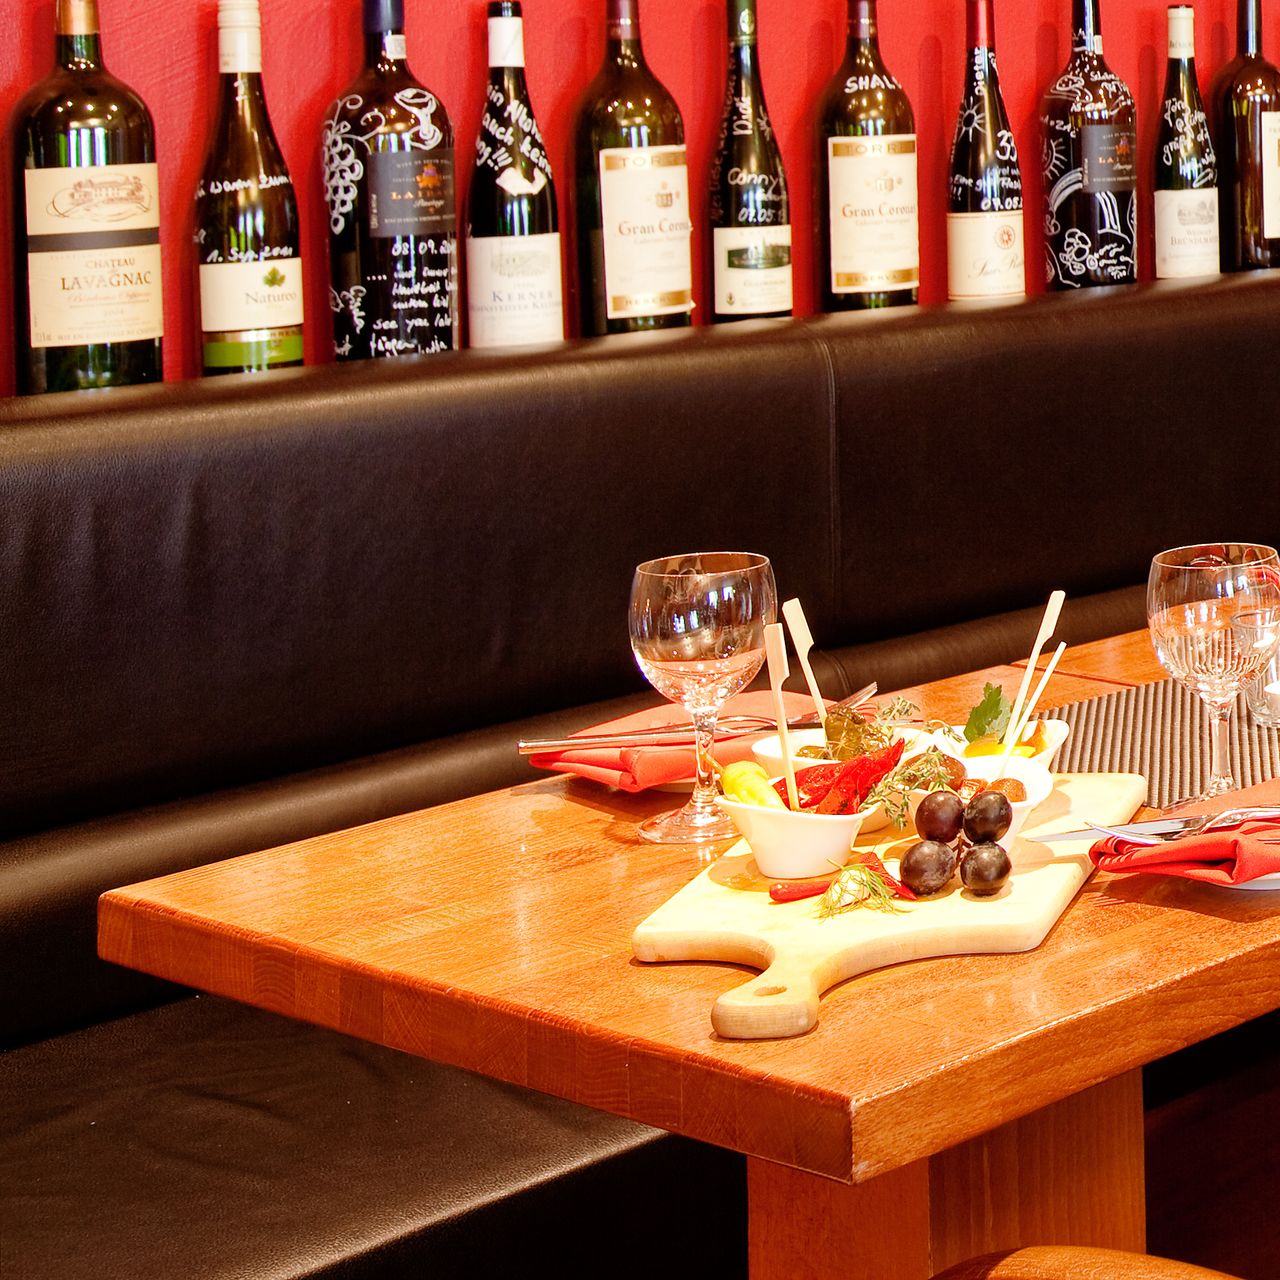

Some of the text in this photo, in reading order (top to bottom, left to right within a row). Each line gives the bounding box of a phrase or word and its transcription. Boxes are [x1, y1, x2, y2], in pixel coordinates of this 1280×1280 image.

[973, 47, 984, 96] Dieter
[727, 166, 779, 197] Conny
[842, 204, 875, 219] Gran
[617, 219, 655, 236] Gran
[61, 270, 152, 291] LAVAGNAC
[491, 290, 554, 302] KERNER
